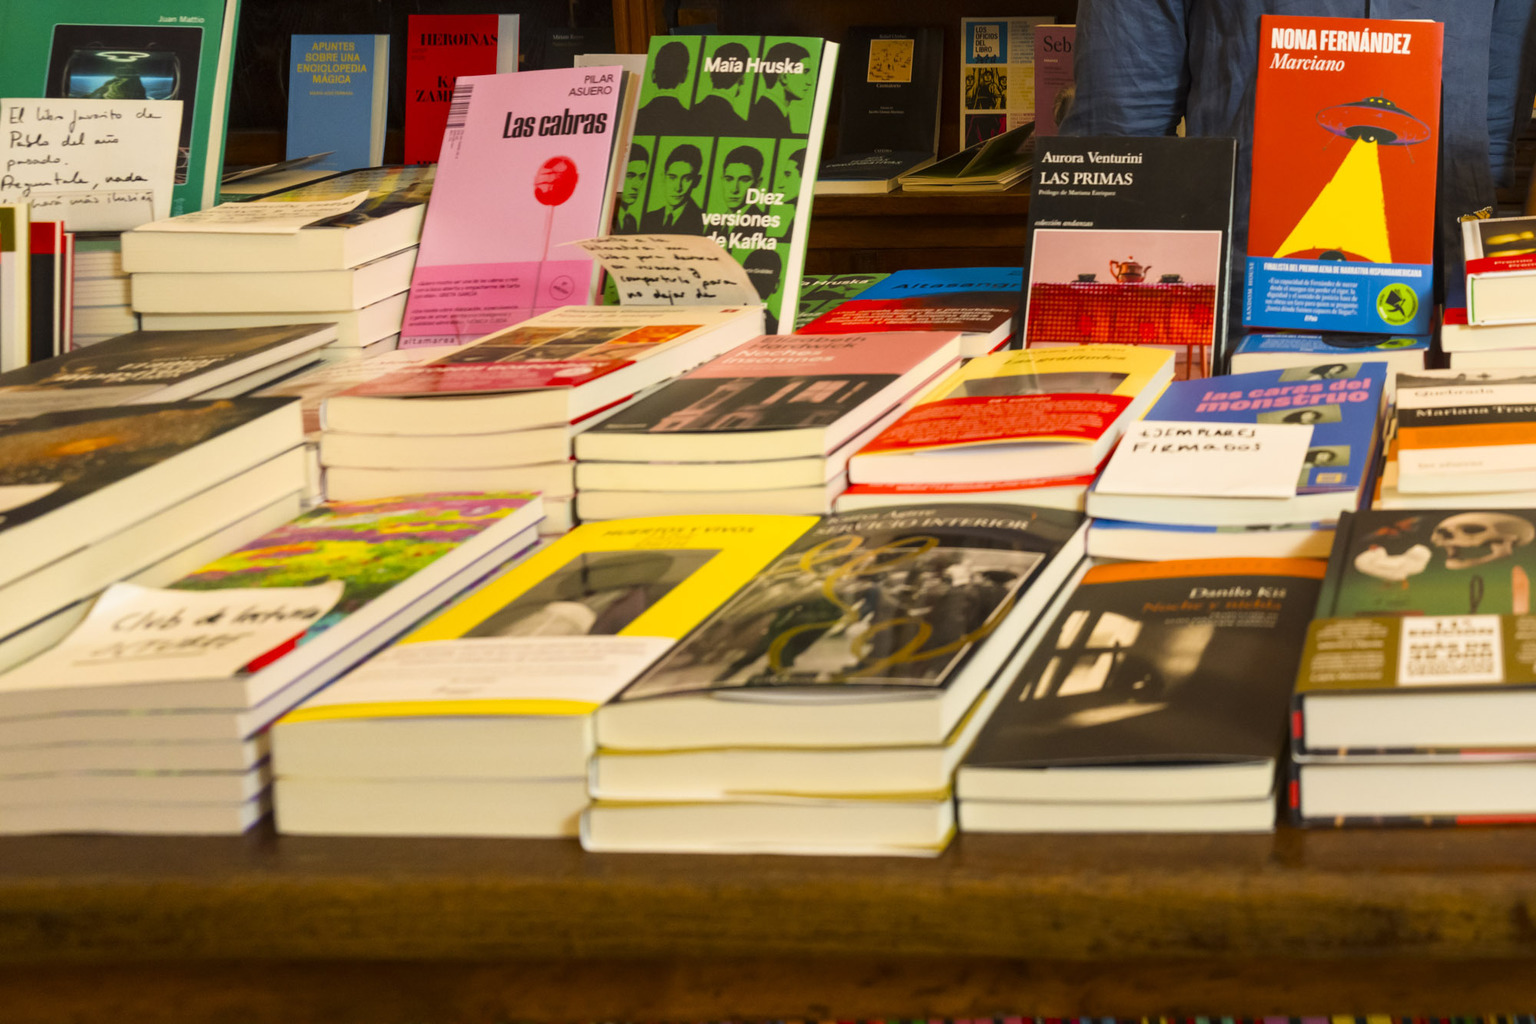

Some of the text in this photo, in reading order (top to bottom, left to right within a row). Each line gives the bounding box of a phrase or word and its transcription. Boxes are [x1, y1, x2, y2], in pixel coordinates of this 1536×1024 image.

[158, 15, 178, 23] Juan
[975, 25, 988, 33] LOS
[975, 32, 999, 40] OFICIOS
[312, 42, 356, 51] APUNTES
[1271, 28, 1412, 55] NONA FERNÁNDEZ
[975, 46, 993, 54] LIBRO
[305, 53, 361, 62] SOBRE UNA
[1269, 53, 1346, 72] Marciano
[297, 63, 368, 73] ENCICLOPEDIA
[704, 57, 804, 75] Maïa Hruska
[312, 73, 352, 85] MÁGICA
[584, 75, 614, 84] PILAR
[568, 86, 613, 97] ASUERO
[502, 108, 608, 139] Las cabras
[10, 132, 51, 149] Pablo
[62, 133, 86, 147] del
[1041, 151, 1143, 164] Aurora Venturini
[1039, 171, 1134, 186] LAS PRIMAS
[745, 188, 785, 205] Diez
[702, 211, 781, 228] versiones
[706, 232, 777, 250] de Kafka
[1494, 256, 1531, 266] Premio
[1263, 262, 1289, 271] FINALISTA
[1290, 264, 1299, 272] DEL
[1299, 264, 1319, 273] PREMIO
[1340, 266, 1369, 275] NARRATIVA
[1369, 267, 1422, 277] HISPANOAMERICANA
[403, 337, 456, 347] altamarea
[761, 333, 868, 348] Elizabeth
[721, 353, 836, 367] insomnes
[733, 347, 823, 361] Noches
[1201, 377, 1371, 402] las caras del
[1195, 389, 1370, 414] monstruo
[1415, 406, 1492, 418] Mariana
[812, 517, 1031, 536] SERVICIO INTERIOR
